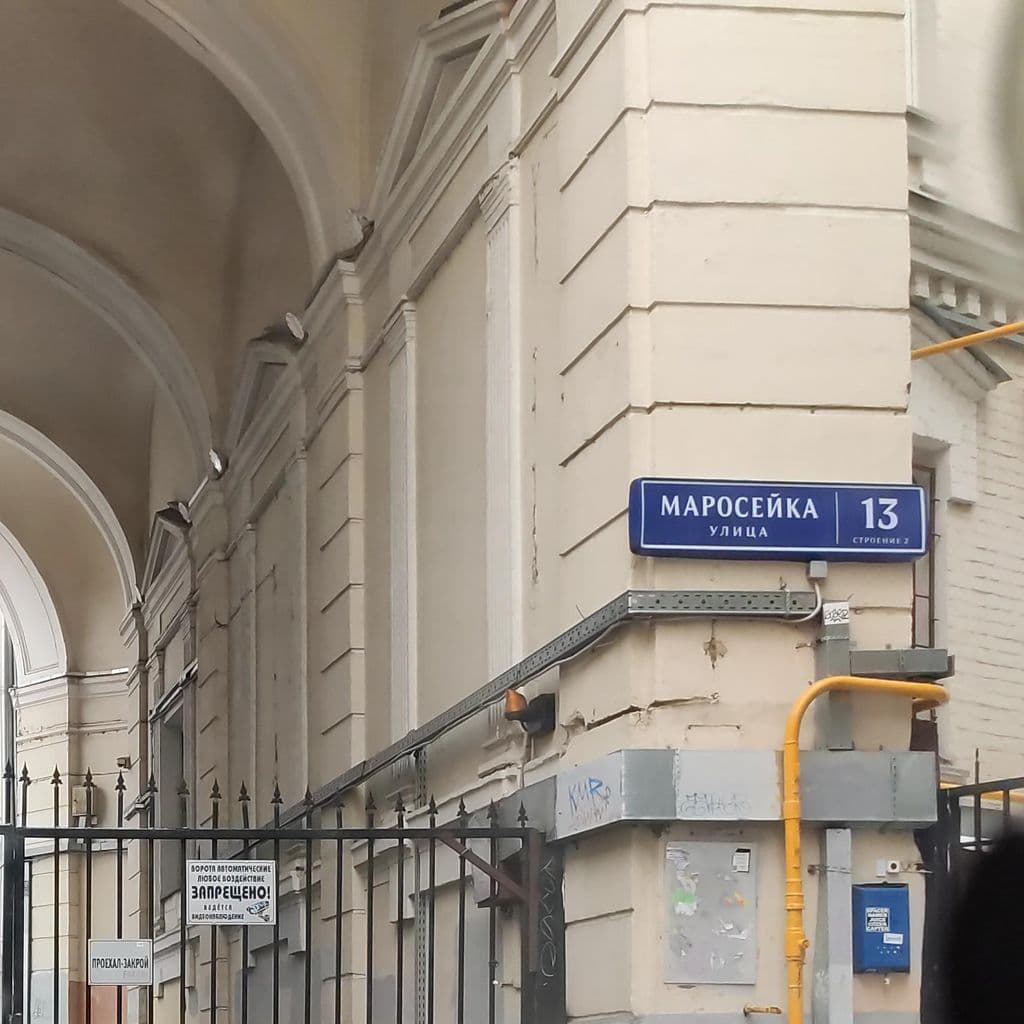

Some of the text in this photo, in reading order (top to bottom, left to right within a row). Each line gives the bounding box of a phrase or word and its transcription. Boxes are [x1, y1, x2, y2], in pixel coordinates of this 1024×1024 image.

[660, 493, 819, 519] МАРОСЕЙКА
[861, 497, 898, 530] 13
[709, 525, 769, 539] УЛИЦА
[852, 536, 901, 545] СТРОЕНИЕ
[191, 865, 271, 873] ВОРОТА АВТОМАТИЧЕСКИЕ
[197, 874, 265, 883] ЛЮБОЕ ВОЗДЕЙСТВИЕ
[191, 885, 271, 901] ЗАПРЕЩЕНО!
[92, 956, 149, 969] ПРОЕХАЛ-ЗАКРОЙ
